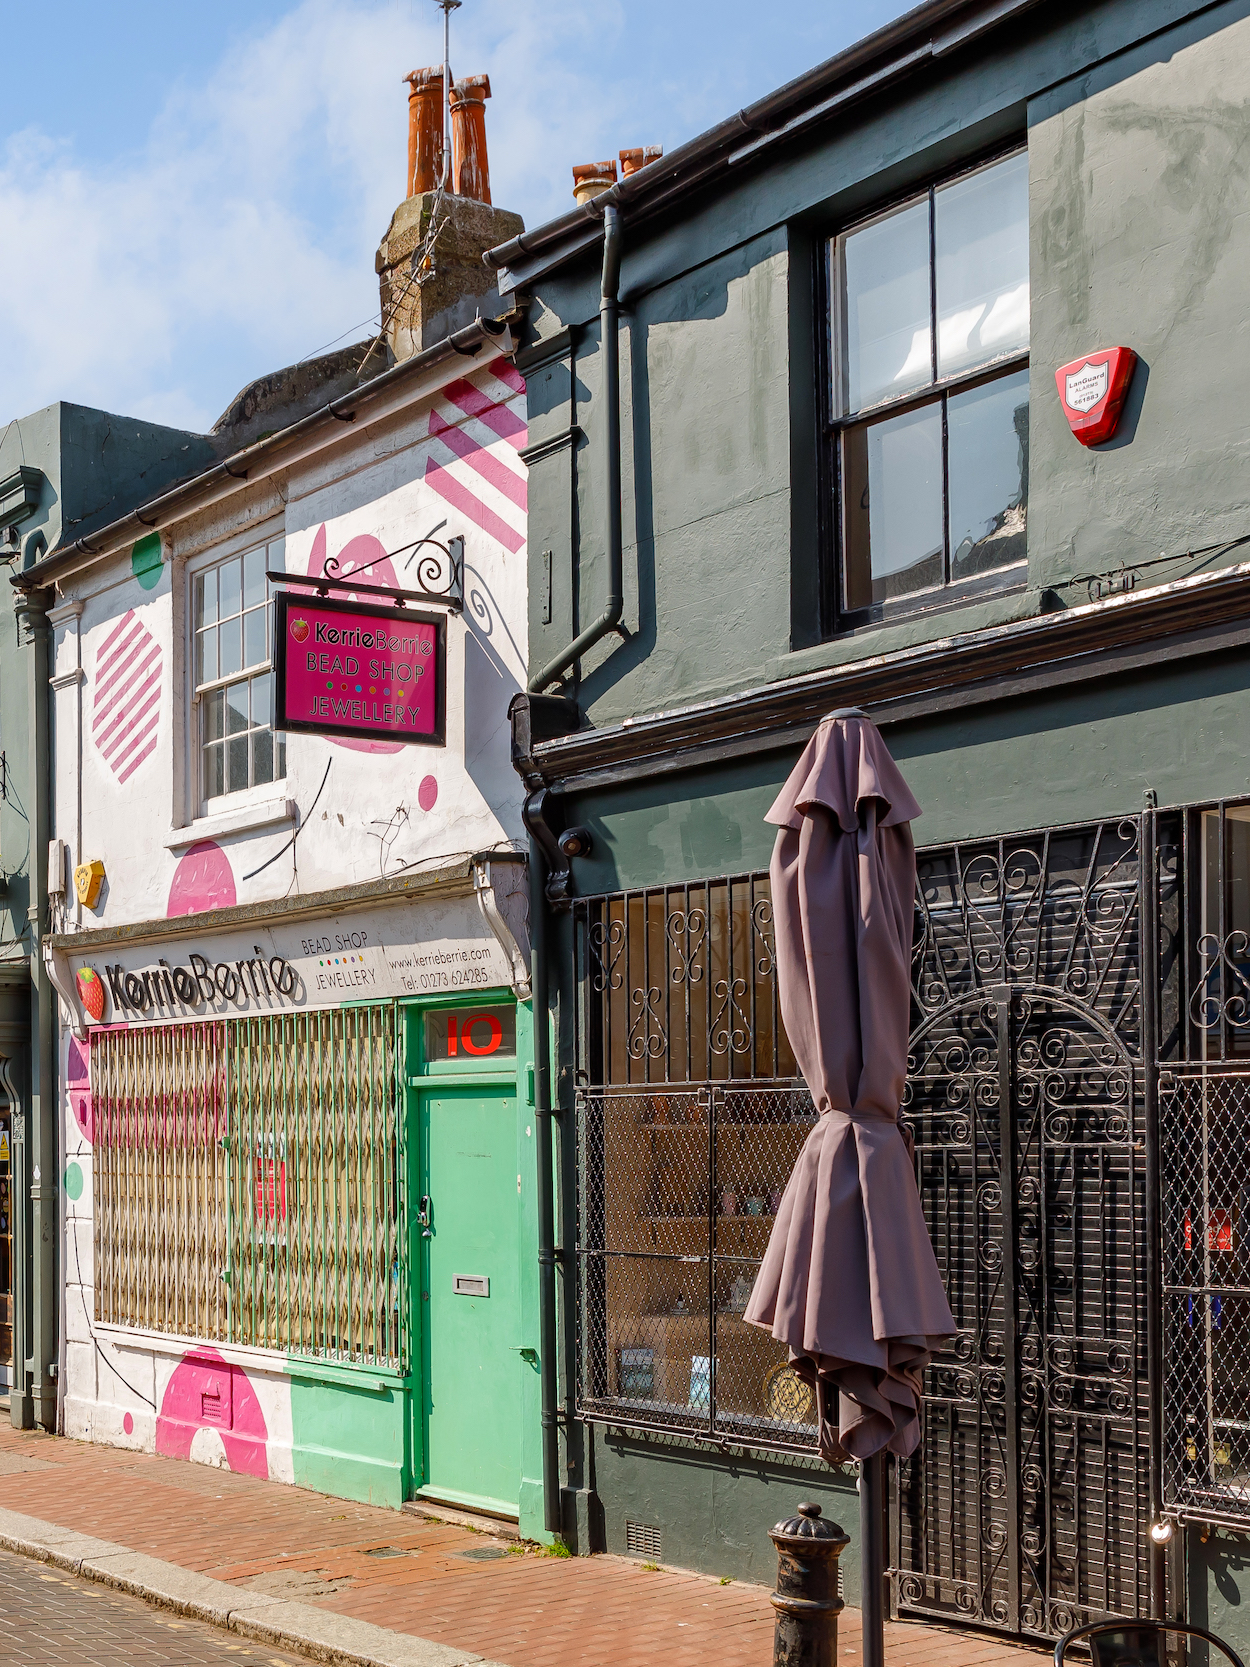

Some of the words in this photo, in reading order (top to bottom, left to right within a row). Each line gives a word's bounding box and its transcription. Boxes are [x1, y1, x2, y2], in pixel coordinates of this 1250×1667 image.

[1069, 372, 1105, 389] LanGuard
[315, 621, 433, 656] KerrieBerrie
[306, 652, 359, 676] BEAD
[369, 659, 425, 683] SHOP
[309, 696, 420, 725] JEWELLERY
[301, 936, 331, 955] BEAD
[335, 931, 368, 950] SHOP
[389, 948, 491, 970] www.kerrieberrie.com
[105, 945, 294, 1010] KerrieBerrie
[315, 968, 376, 990] JEWELLERY
[401, 976, 417, 991] Tel:
[420, 972, 448, 989] 01273
[452, 968, 488, 986] 624285
[447, 1013, 503, 1056] 10
